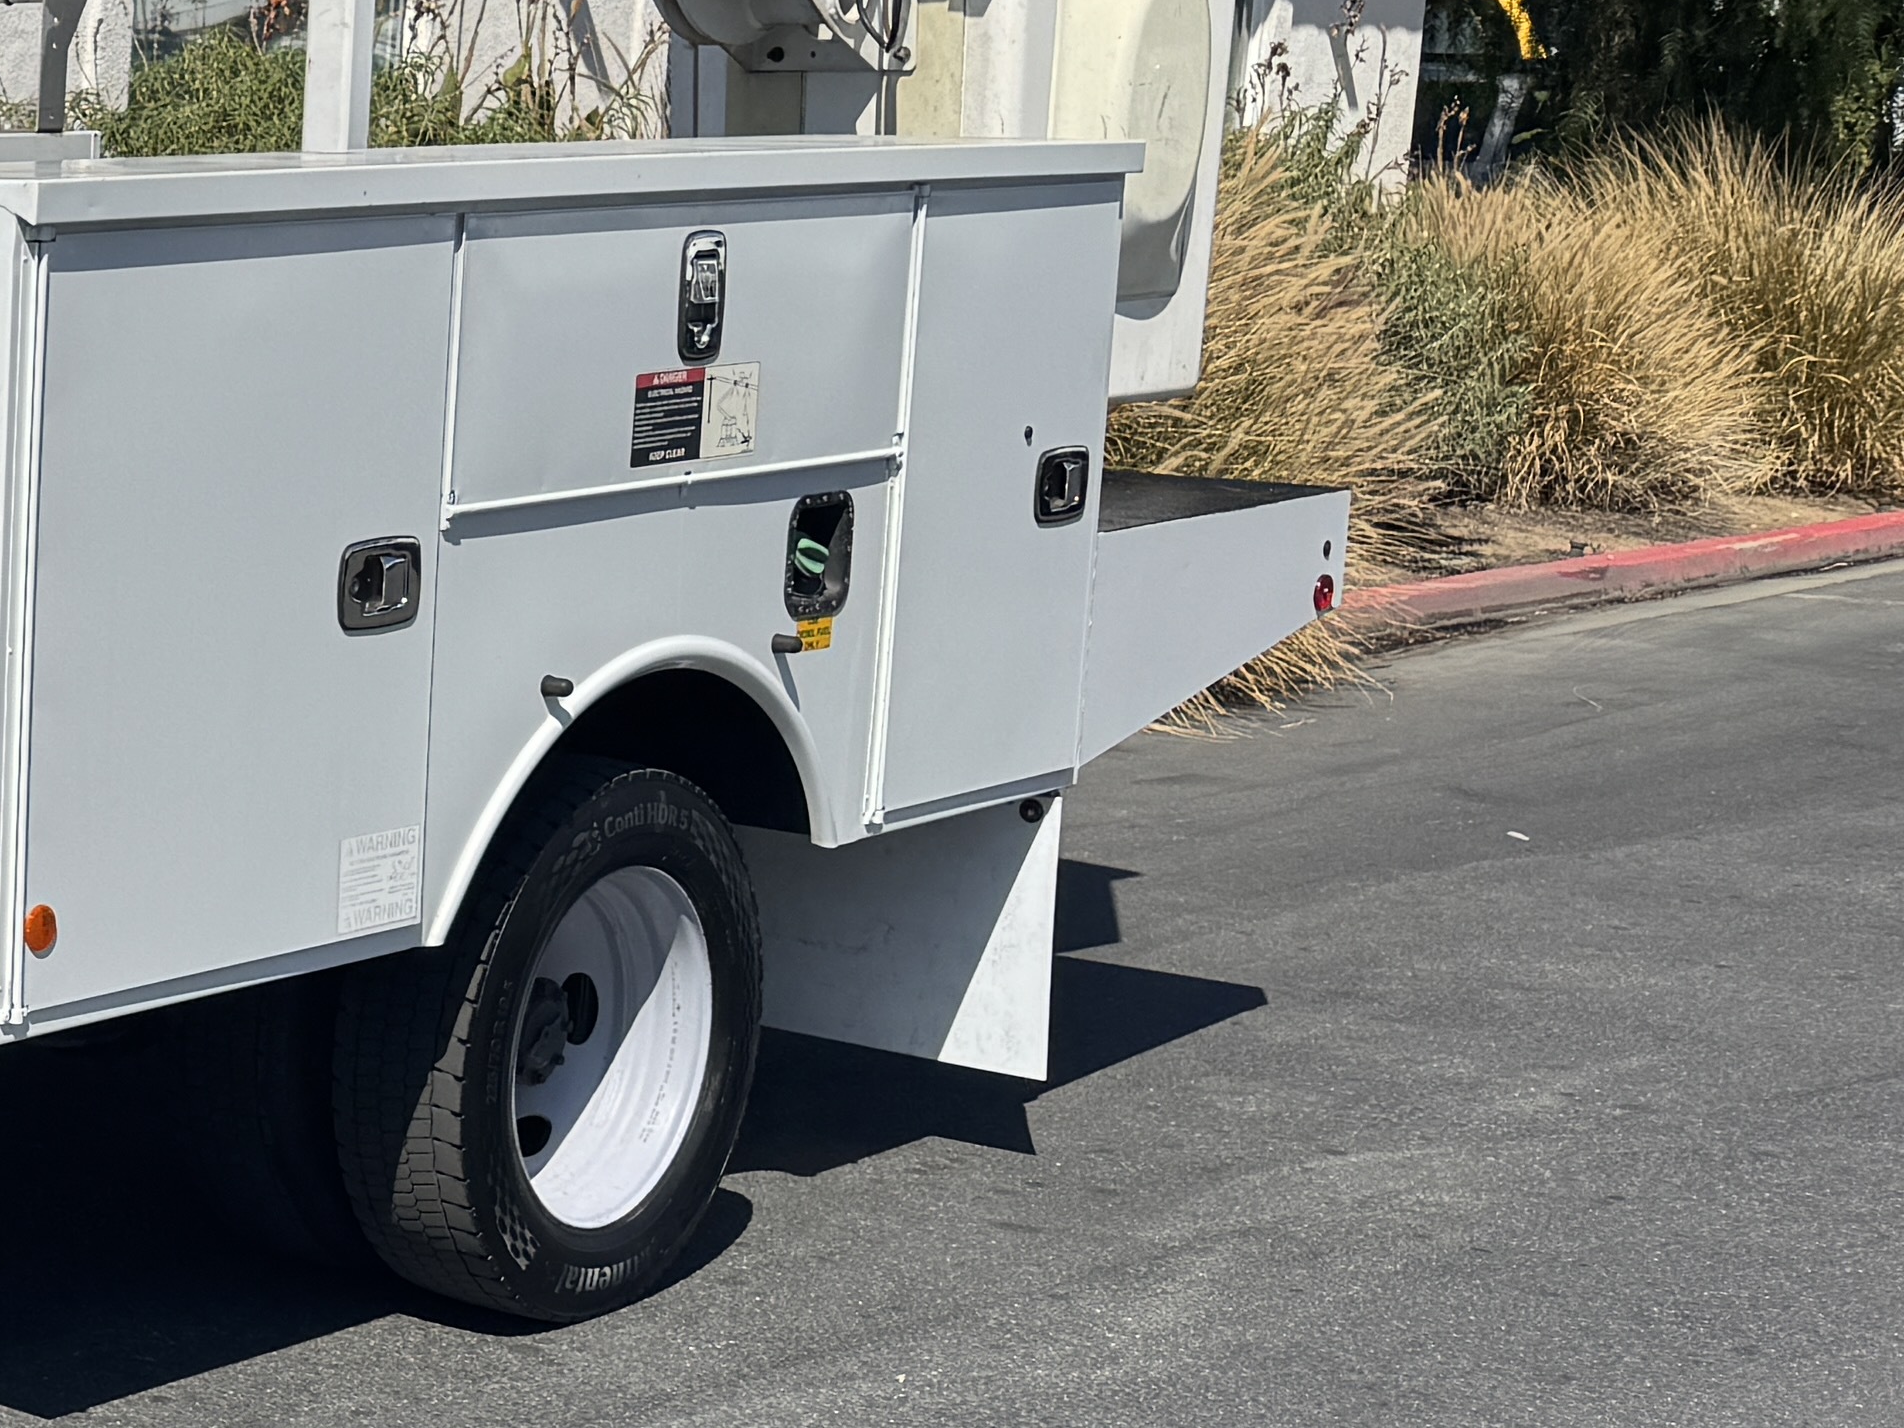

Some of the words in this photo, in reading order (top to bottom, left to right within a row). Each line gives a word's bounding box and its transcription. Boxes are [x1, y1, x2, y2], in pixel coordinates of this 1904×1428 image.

[604, 803, 644, 838] Conti
[355, 828, 416, 855] WARNING
[353, 898, 413, 927] WARNING
